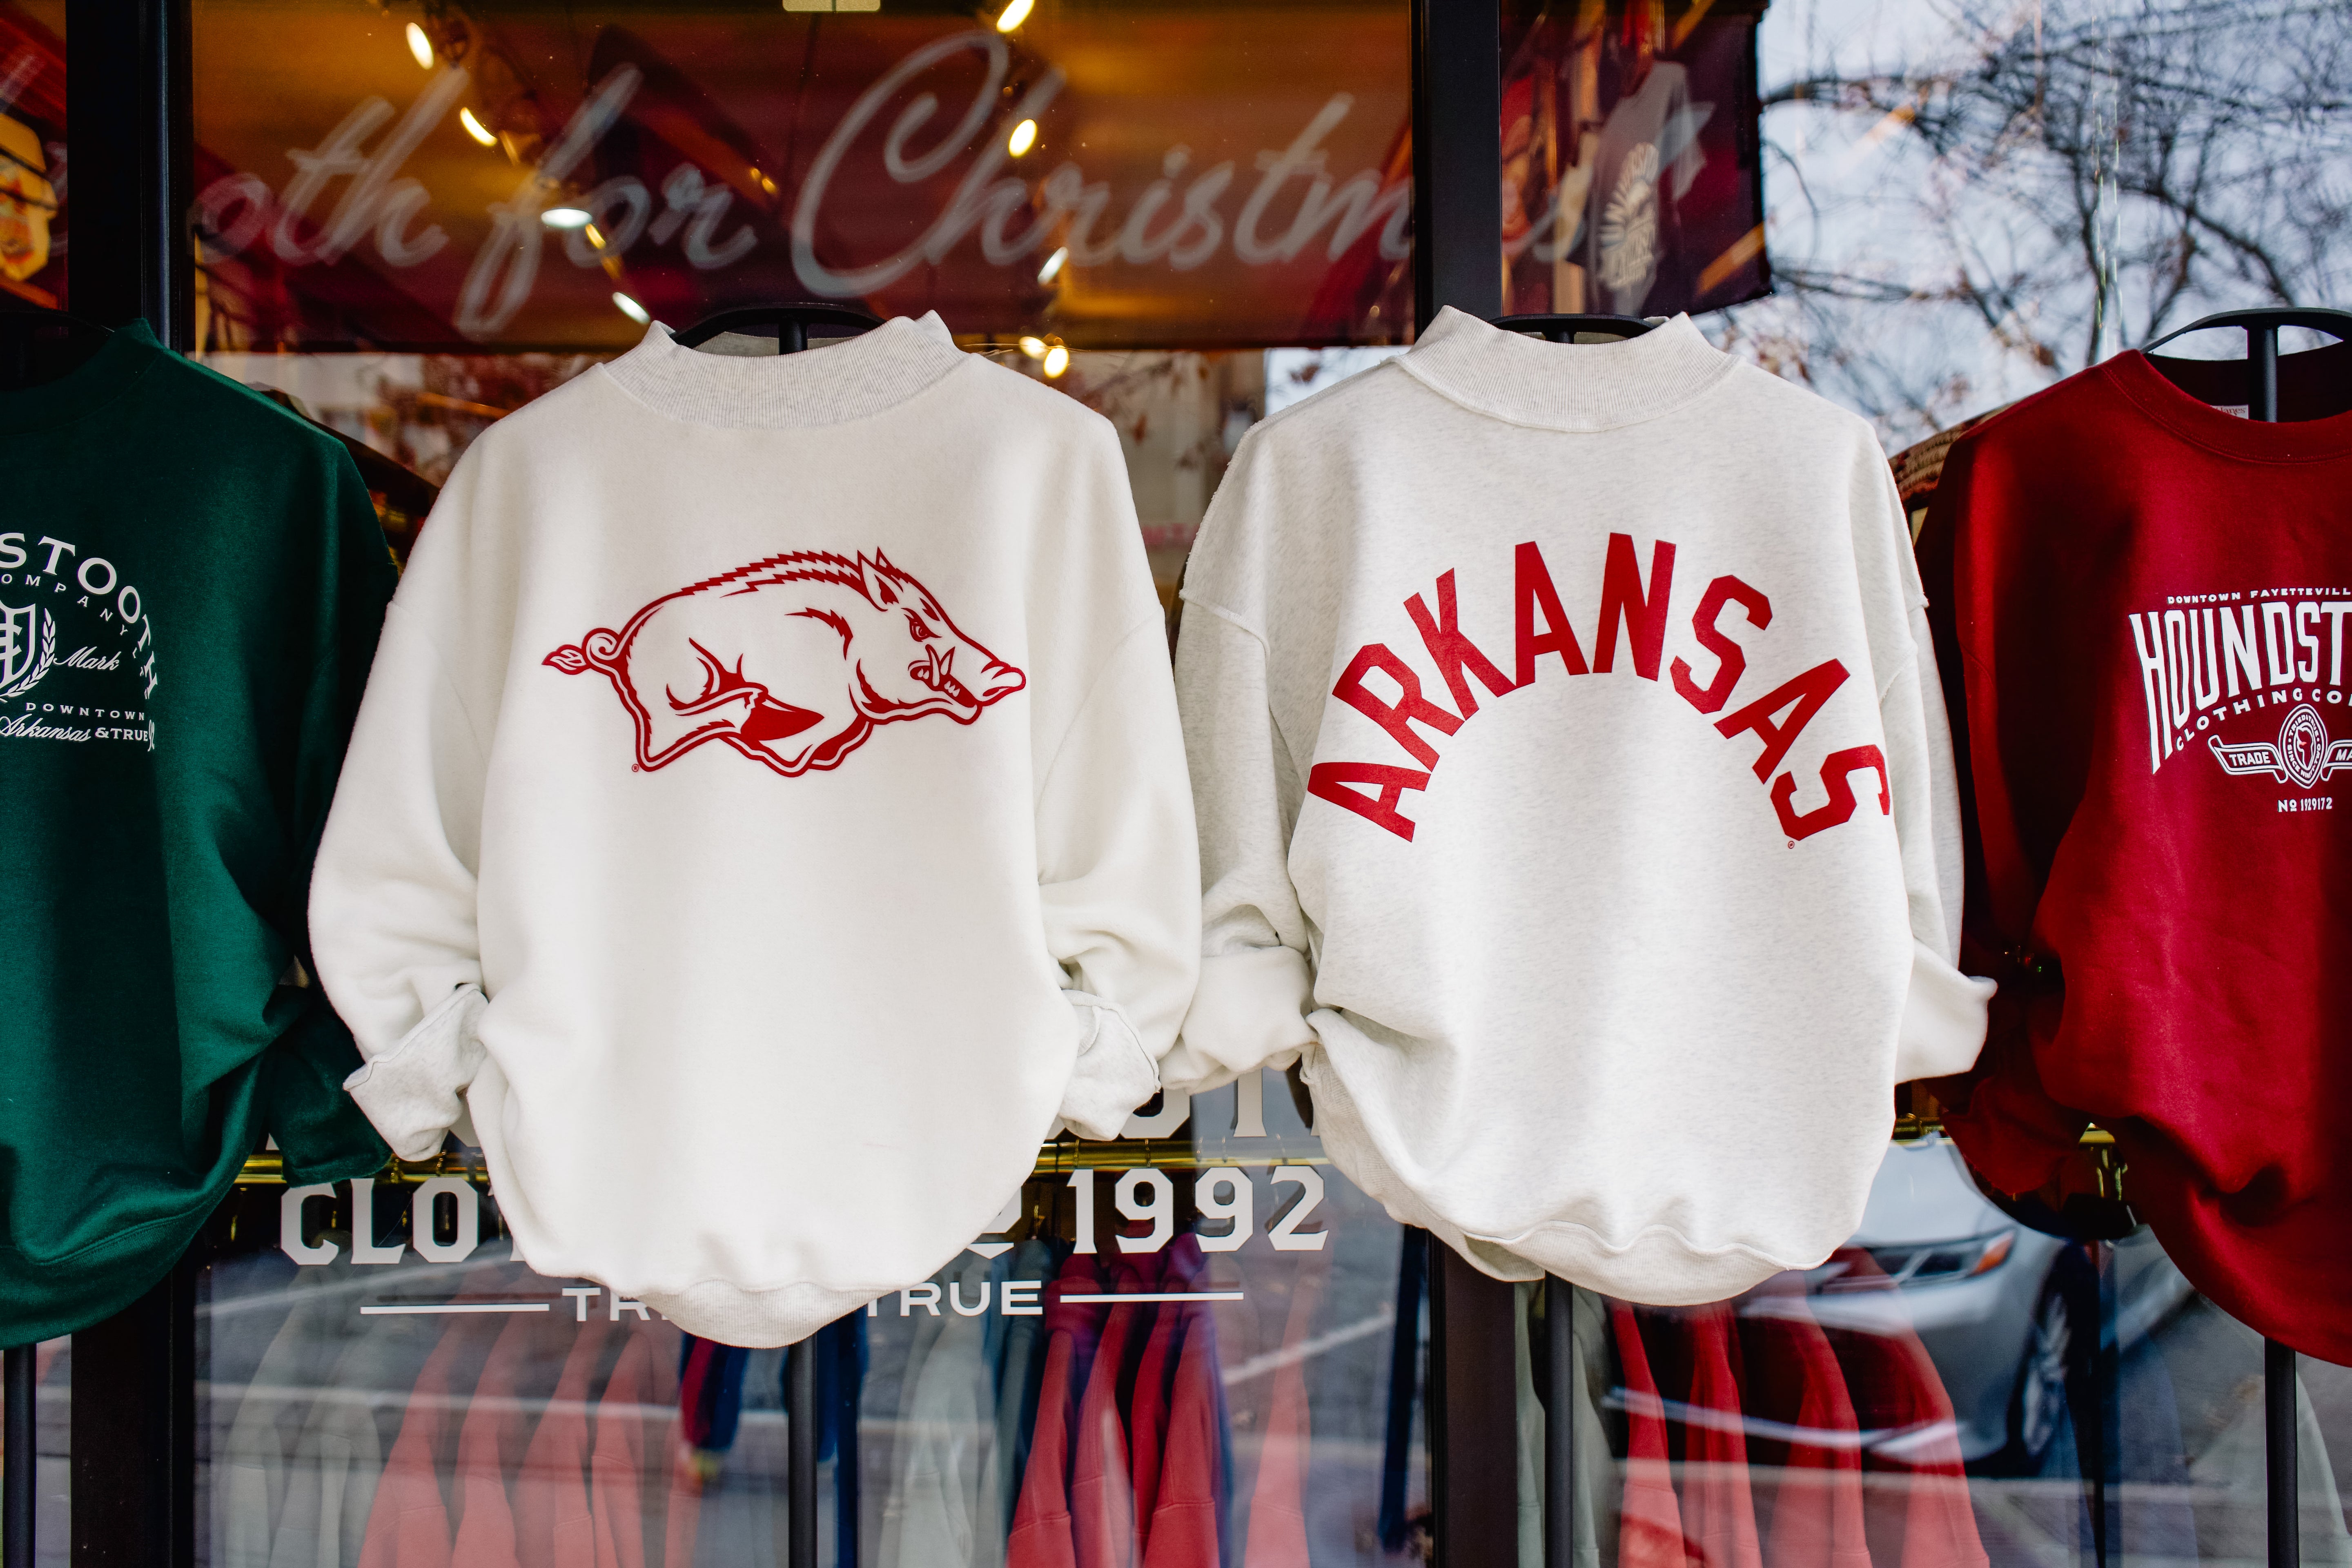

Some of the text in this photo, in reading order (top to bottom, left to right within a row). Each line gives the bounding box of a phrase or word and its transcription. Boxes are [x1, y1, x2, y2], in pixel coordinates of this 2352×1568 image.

[450, 61, 759, 341] for
[2167, 587, 2351, 604] DOWNTOWN FAYETTEVILL
[52, 646, 121, 670] Mark
[1307, 532, 1891, 842] ARKANSAS
[2129, 601, 2352, 775] HOUNDST
[0, 713, 91, 742] Arkansas
[26, 702, 145, 721] DOWNTOWN
[2176, 688, 2352, 751] CLOTHING CO
[2229, 751, 2271, 766] TRADE
[280, 1176, 527, 1265] CLO
[1067, 1165, 1329, 1254] 1992
